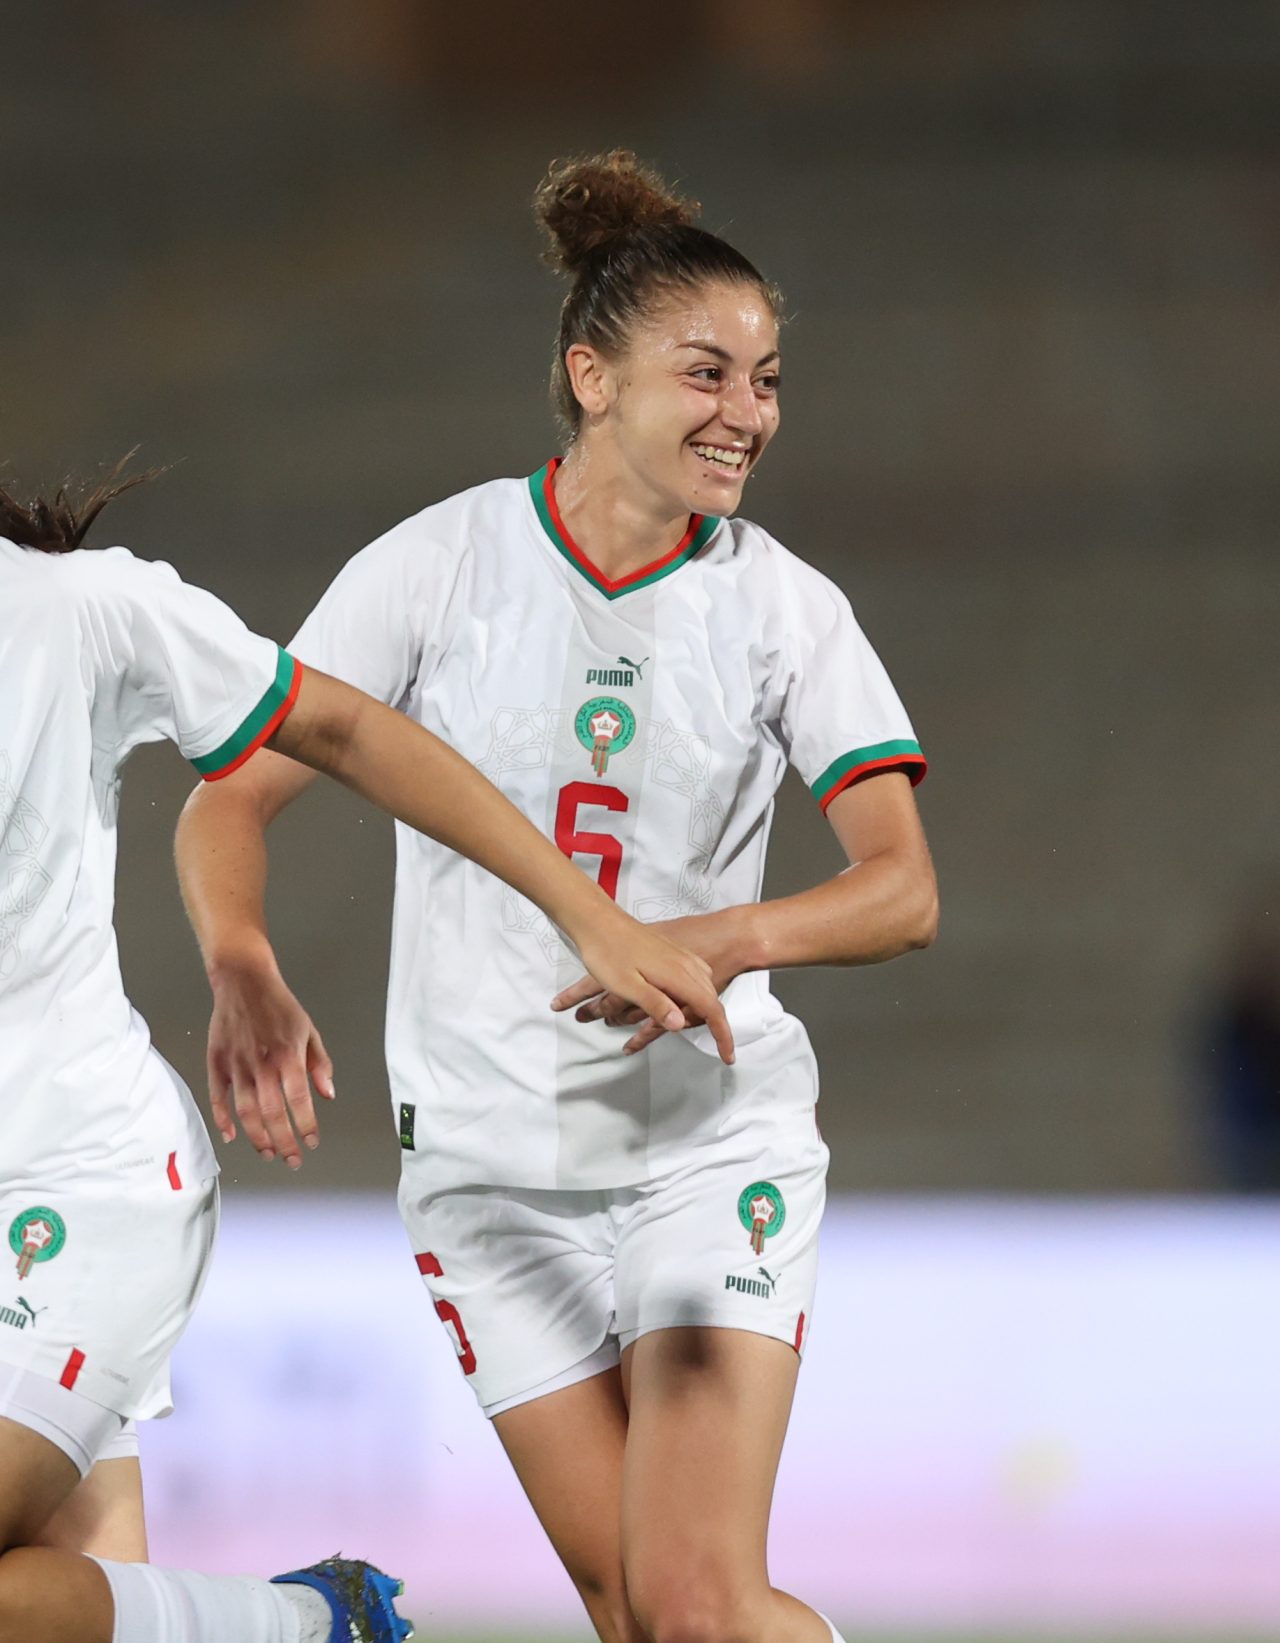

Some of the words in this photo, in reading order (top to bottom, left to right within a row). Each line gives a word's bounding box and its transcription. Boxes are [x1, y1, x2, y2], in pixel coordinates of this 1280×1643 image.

[584, 669, 634, 687] PUMA
[554, 781, 629, 901] 6
[725, 1274, 770, 1299] PUMA
